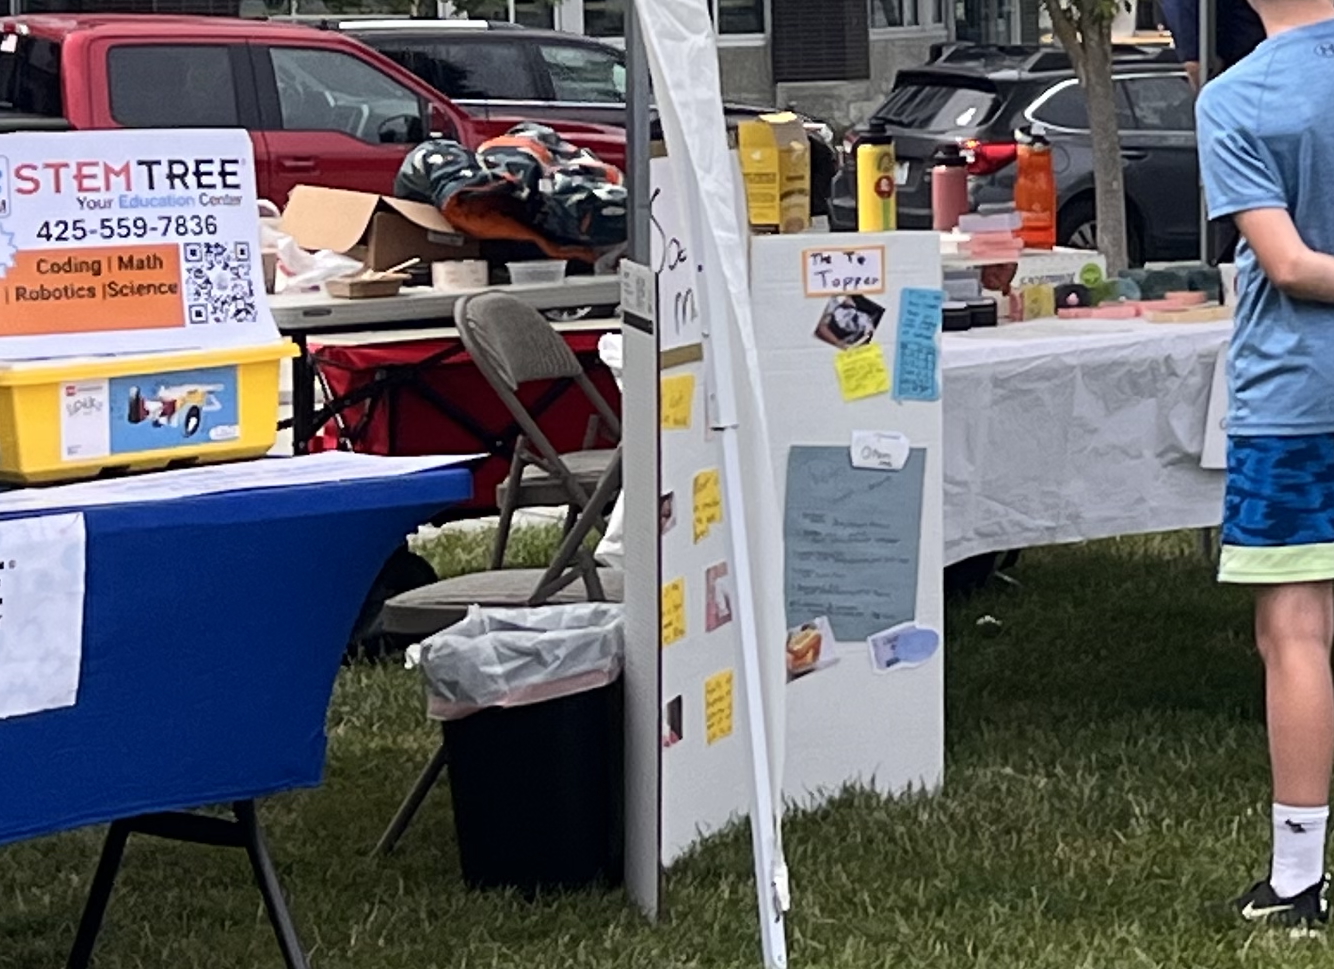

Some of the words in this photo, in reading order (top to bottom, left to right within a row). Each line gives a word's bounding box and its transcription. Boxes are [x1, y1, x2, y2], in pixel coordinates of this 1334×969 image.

[76, 195, 113, 211] Your
[118, 193, 194, 209] Education
[199, 192, 243, 208] Center
[36, 214, 218, 242] 425-559-7836
[36, 256, 102, 277] Coding
[117, 254, 164, 272] Math
[15, 282, 97, 302] Robotics
